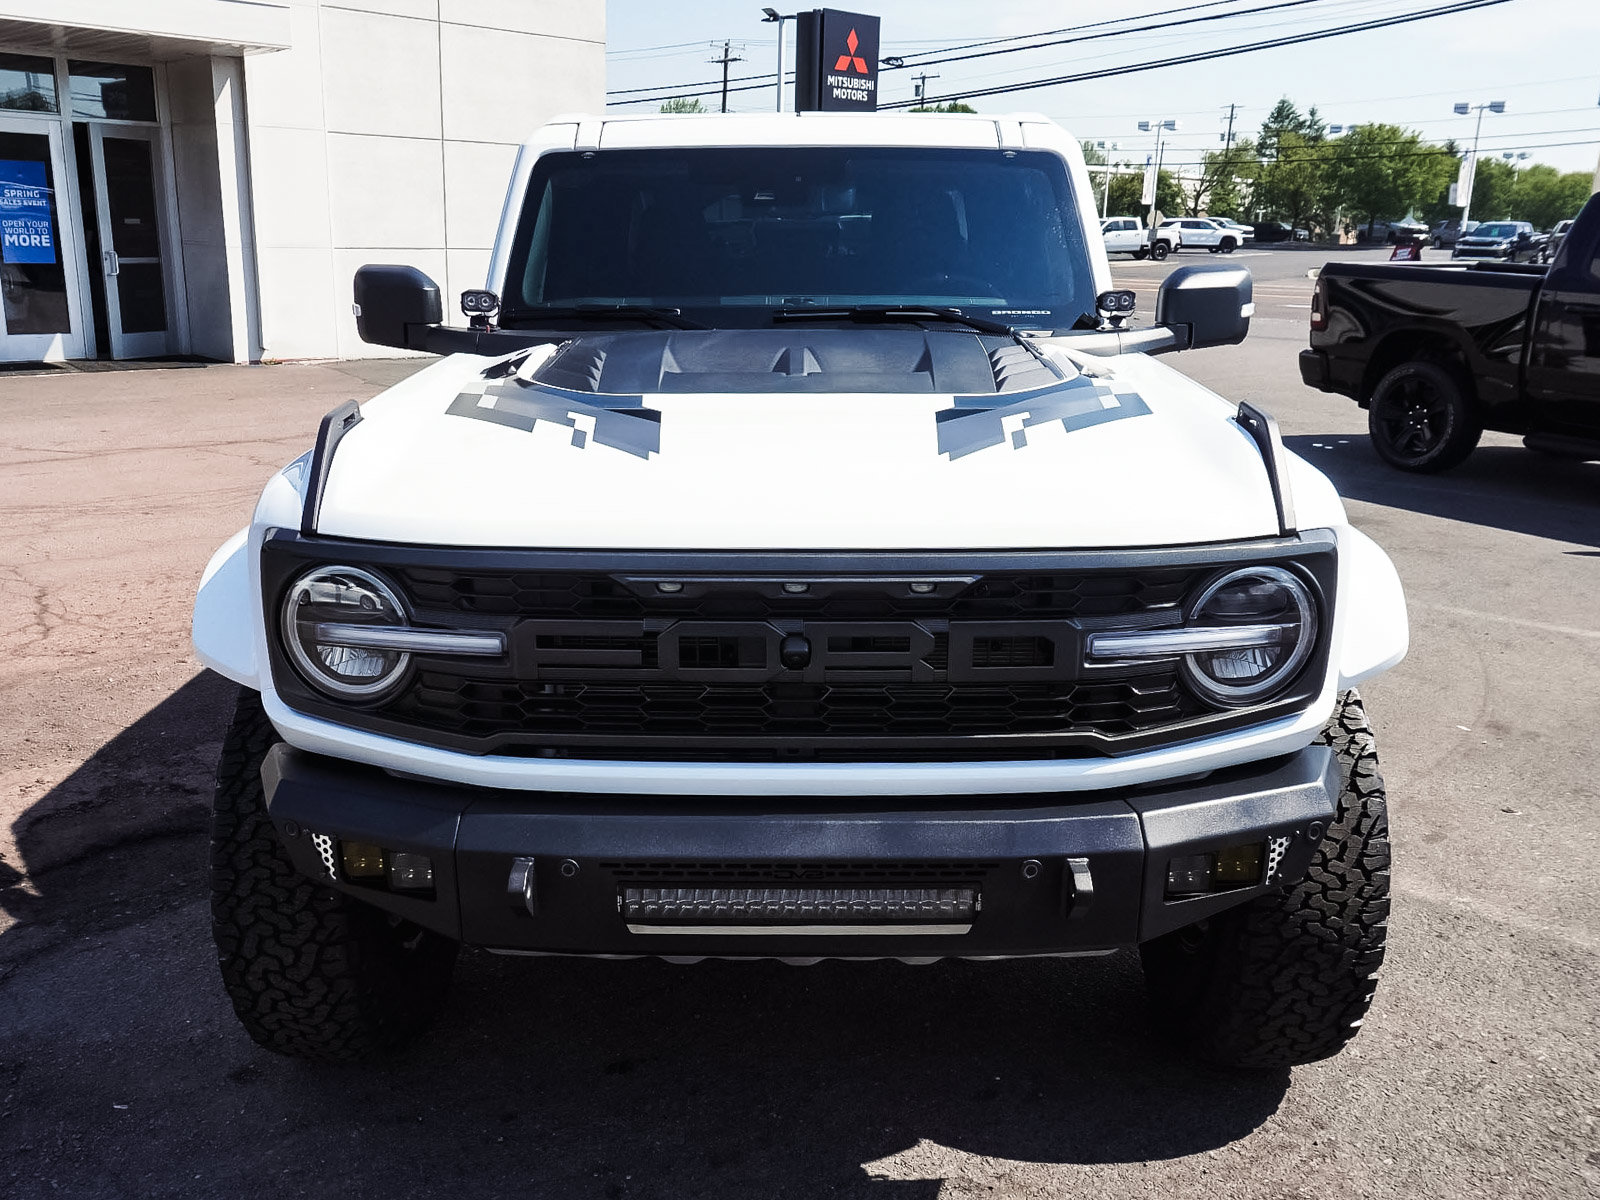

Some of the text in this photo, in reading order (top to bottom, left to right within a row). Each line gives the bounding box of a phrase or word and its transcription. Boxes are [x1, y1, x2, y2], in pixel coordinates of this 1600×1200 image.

[827, 75, 875, 91] MITSUBISHI
[832, 88, 868, 101] MOTORS
[4, 189, 40, 198] SPRING
[5, 227, 48, 235] WORLD TO
[5, 234, 51, 247] MORE
[511, 619, 1083, 682] FORD
